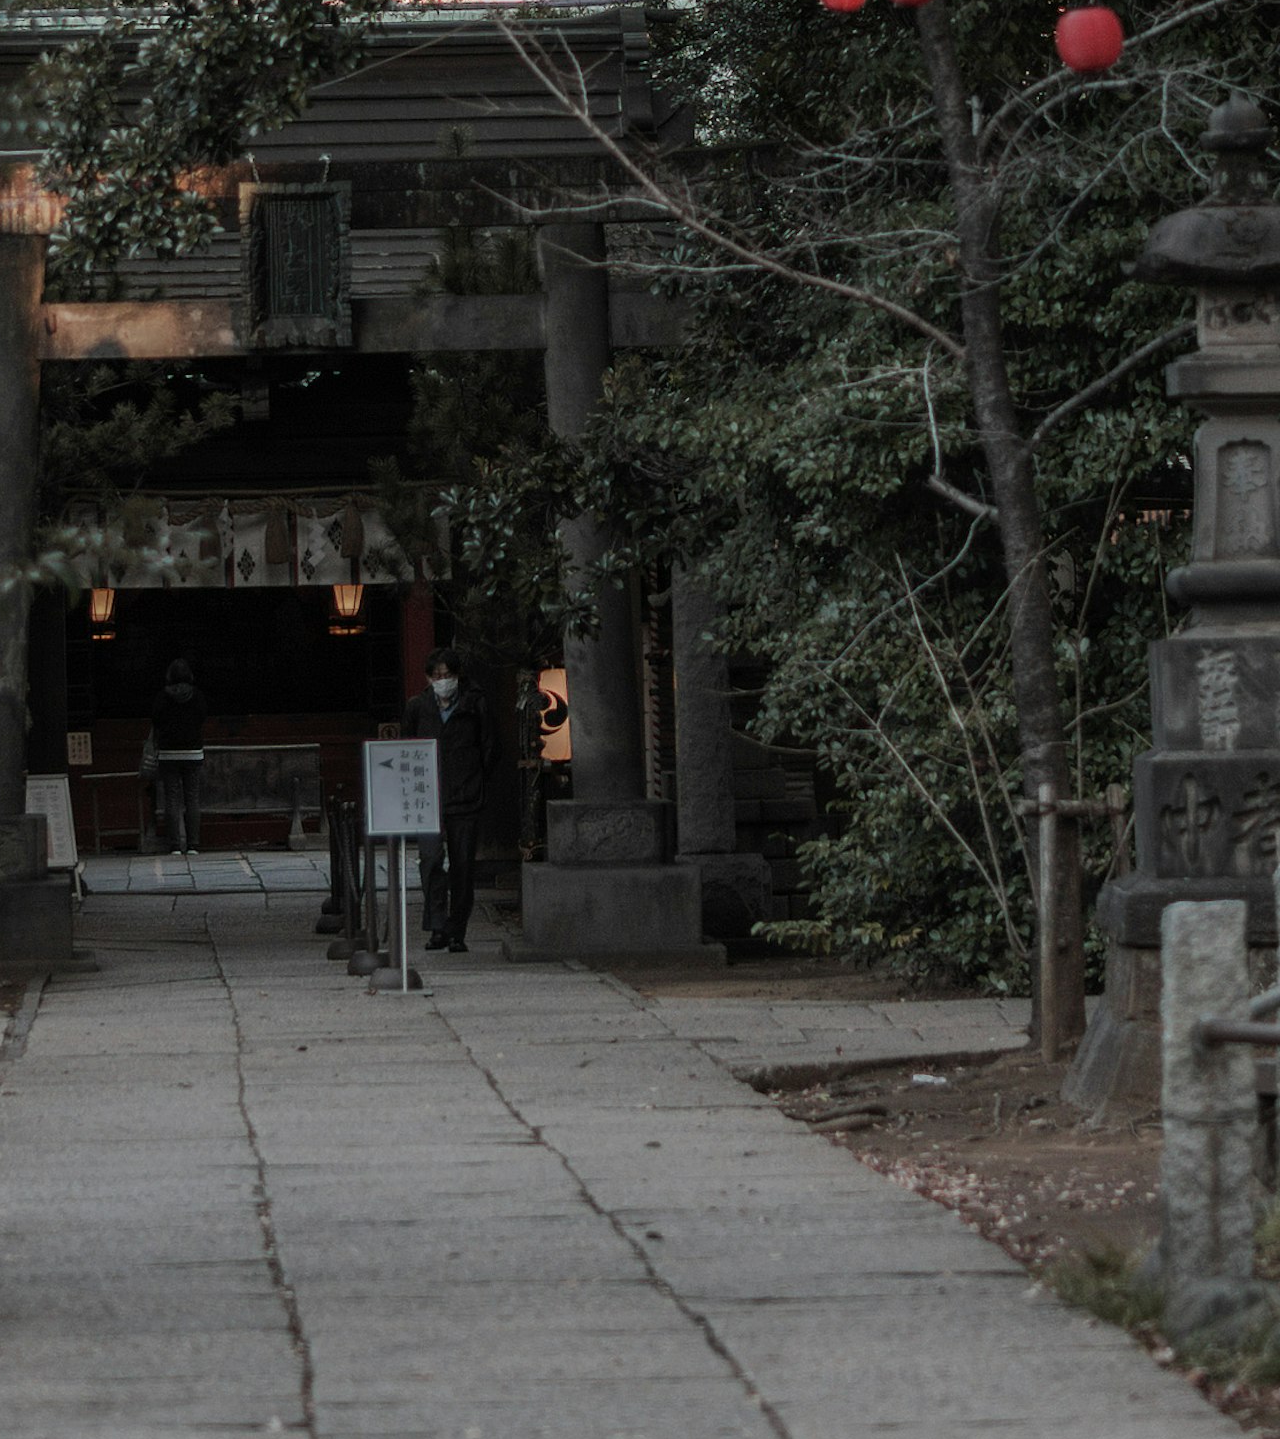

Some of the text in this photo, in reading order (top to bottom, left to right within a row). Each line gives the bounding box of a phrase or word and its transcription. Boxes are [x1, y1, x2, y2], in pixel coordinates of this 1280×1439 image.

[400, 750, 412, 824] お願いします
[412, 749, 426, 824] 左側通行を
